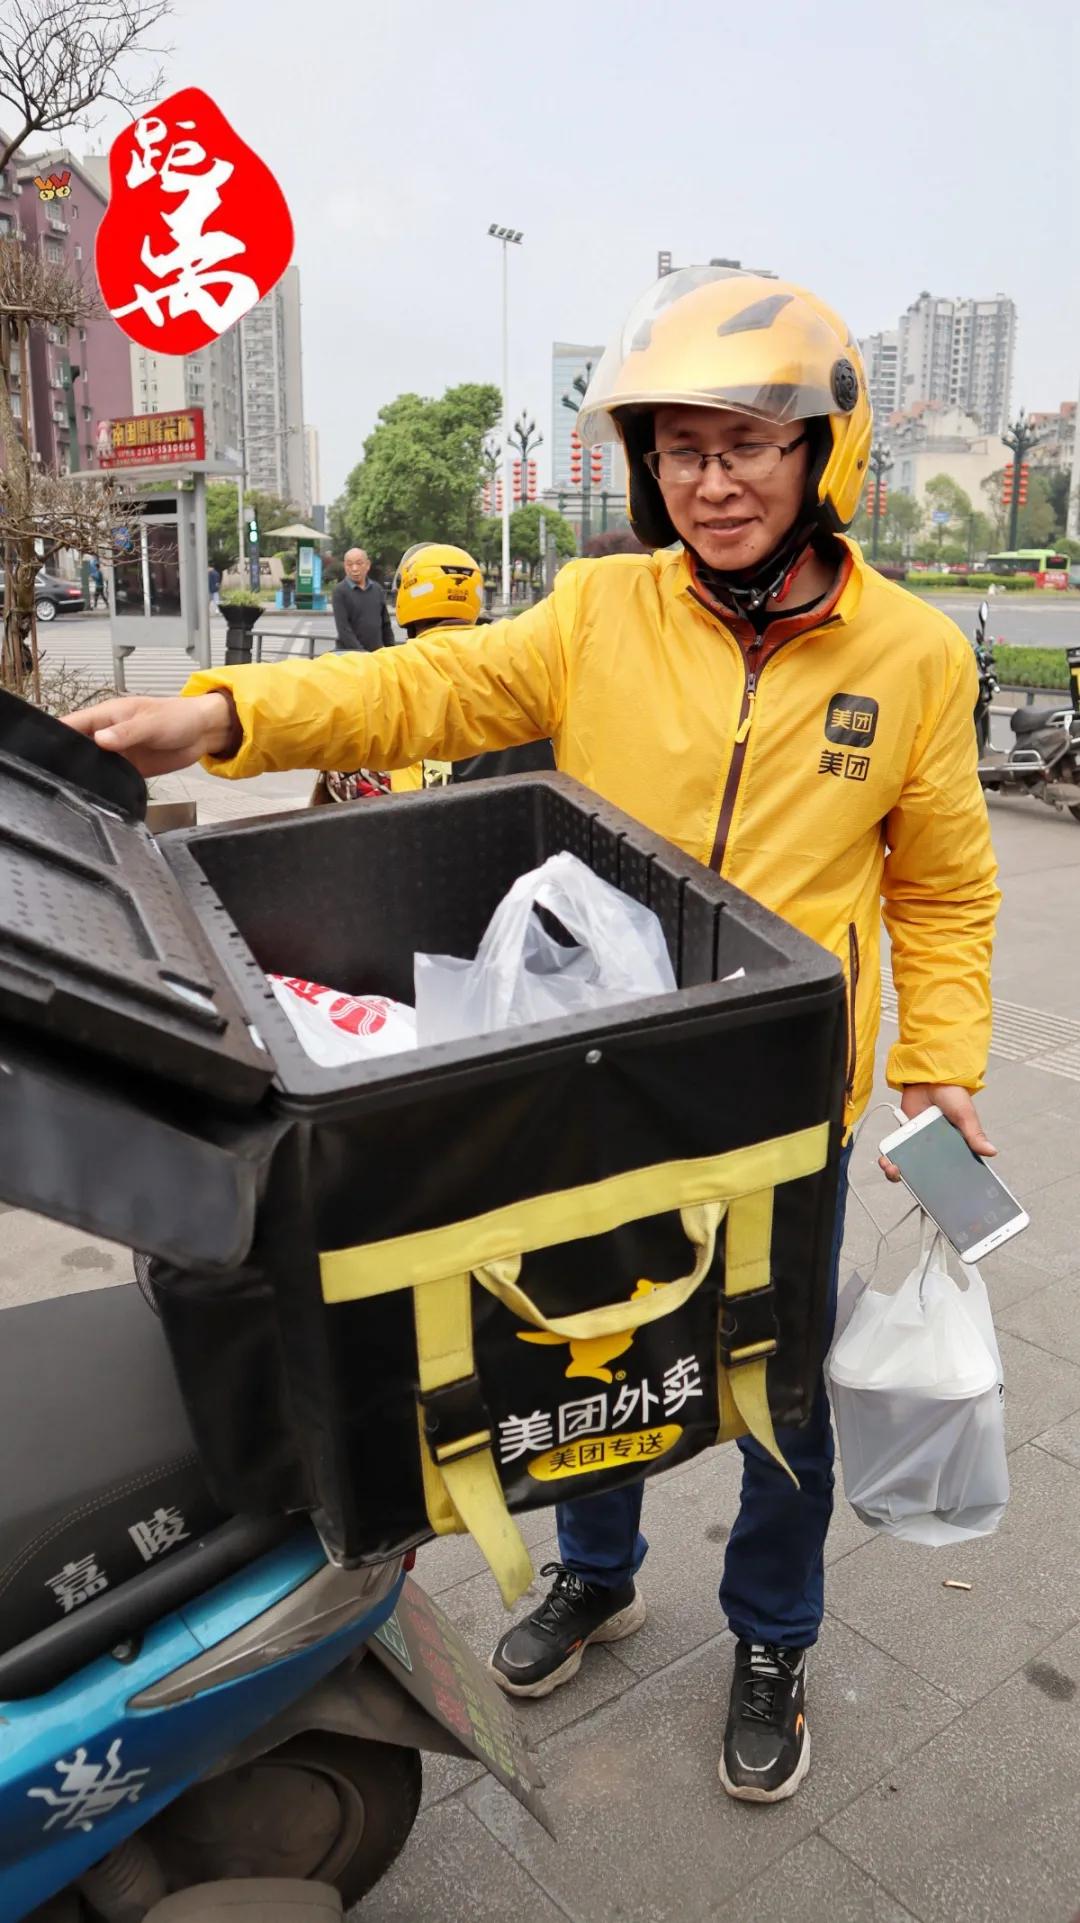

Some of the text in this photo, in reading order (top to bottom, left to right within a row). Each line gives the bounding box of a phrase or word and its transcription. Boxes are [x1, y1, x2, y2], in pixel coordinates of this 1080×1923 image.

[830, 707, 874, 733] 美团
[817, 749, 871, 782] 美团
[498, 1354, 704, 1465] 美团外卖
[550, 1432, 665, 1472] 美团专送
[44, 1506, 192, 1613] 嘉陵
